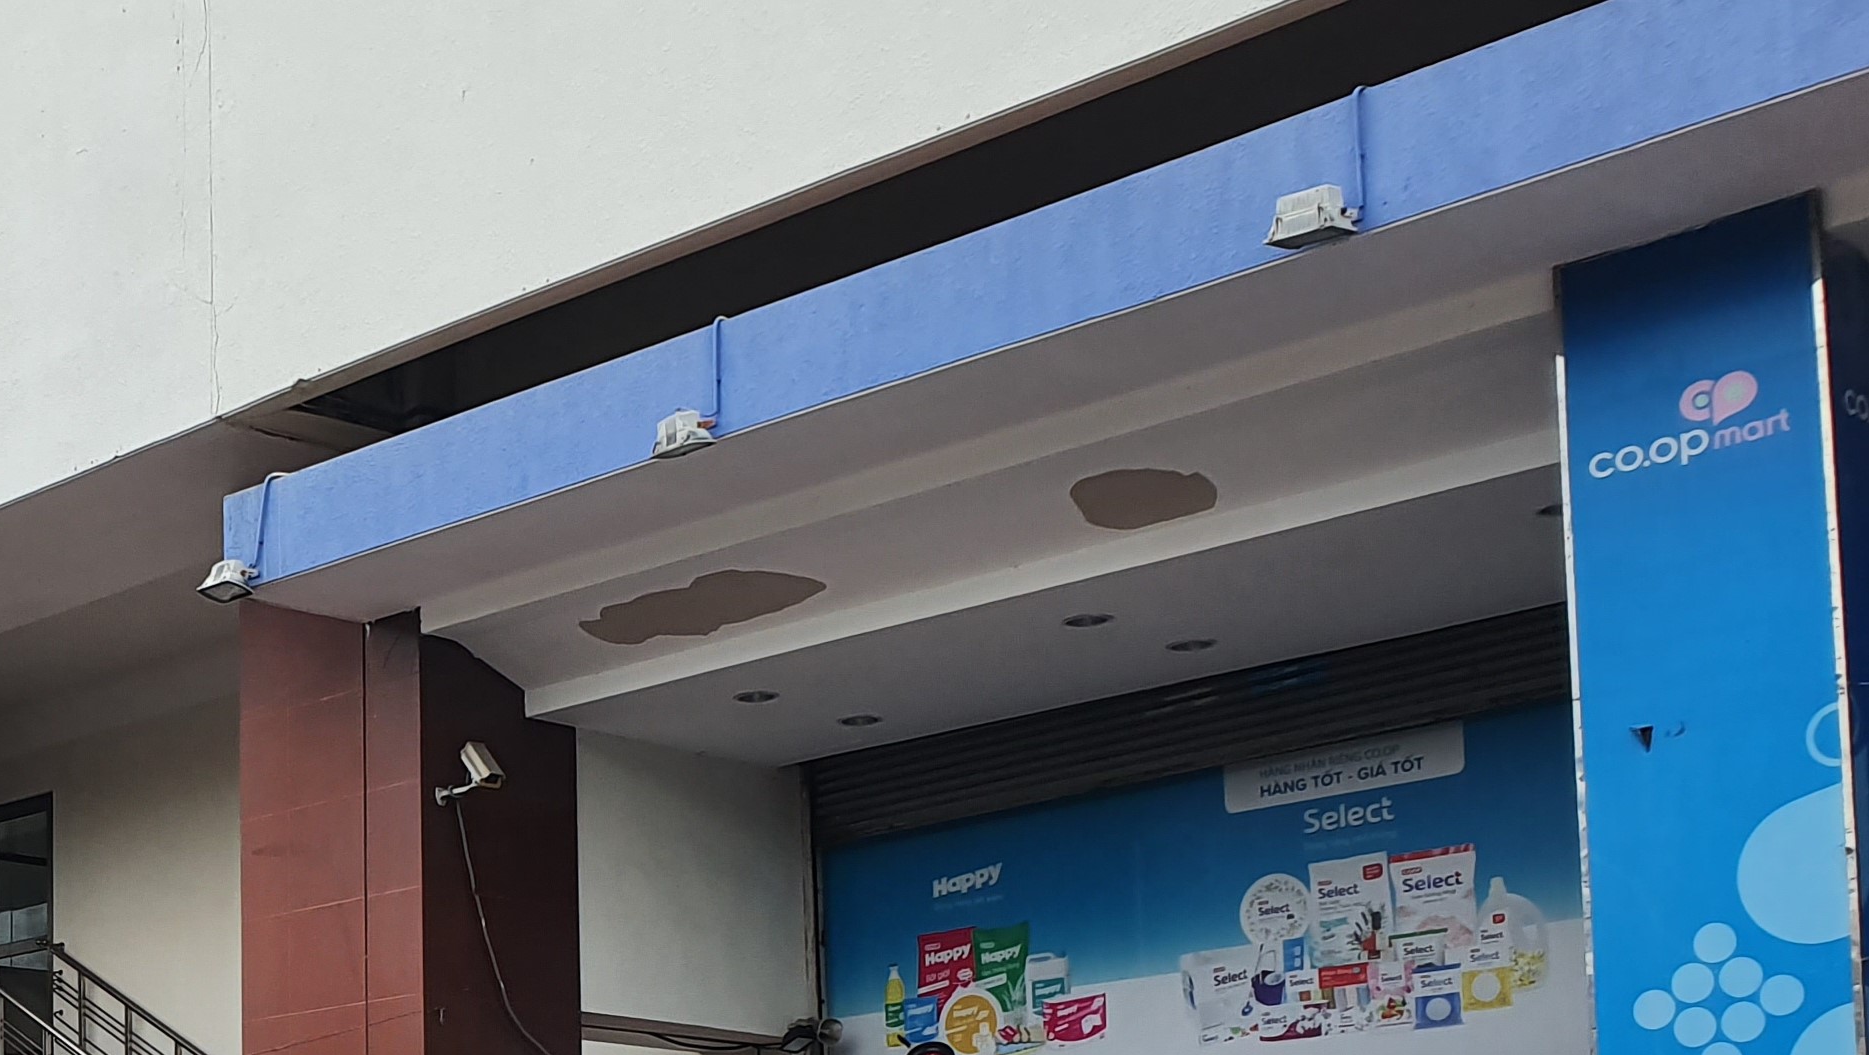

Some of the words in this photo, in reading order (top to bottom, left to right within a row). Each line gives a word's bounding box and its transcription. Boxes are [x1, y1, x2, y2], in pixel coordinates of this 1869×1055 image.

[1260, 777, 1307, 798] HÀNG
[1312, 769, 1343, 789] TỐT
[1357, 762, 1387, 781] GIÁ
[1391, 755, 1424, 774] TỐT
[1303, 797, 1395, 834] Select
[932, 862, 1002, 898] Happy
[1402, 870, 1463, 893] Select
[1318, 883, 1359, 899] Select
[1258, 904, 1290, 916] Select
[925, 943, 972, 967] Happy
[981, 943, 1022, 965] Happy
[1403, 945, 1434, 956] Select
[1470, 952, 1500, 963] Select
[1213, 969, 1248, 986] Select
[1289, 977, 1314, 987] Select
[1421, 978, 1453, 988] Select
